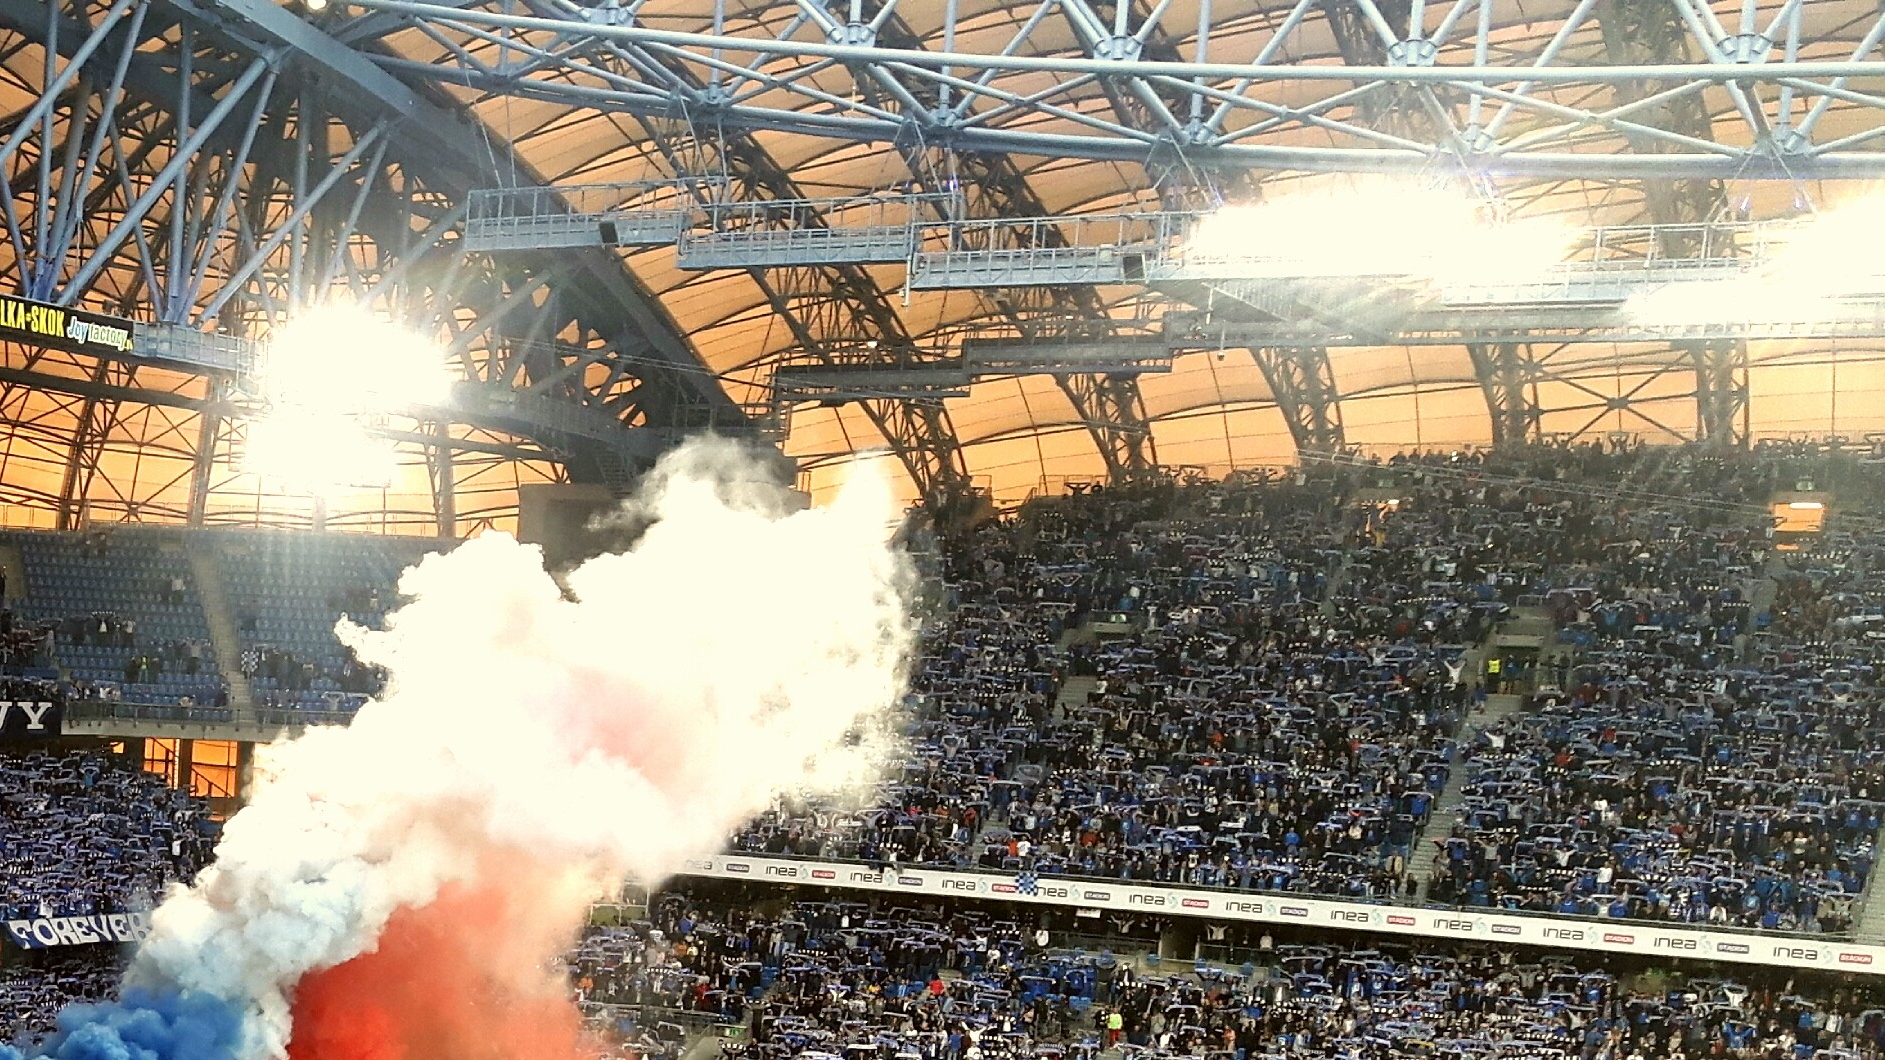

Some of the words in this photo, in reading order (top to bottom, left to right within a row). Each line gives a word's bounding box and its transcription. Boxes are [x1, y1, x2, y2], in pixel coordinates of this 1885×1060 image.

[765, 864, 797, 877] inea
[849, 871, 883, 883] inea
[942, 878, 976, 891] inea
[1036, 885, 1067, 898] nea
[1129, 893, 1165, 906] inea
[1225, 901, 1263, 914] inea
[1330, 910, 1368, 923] inea
[1387, 915, 1415, 926] STADION
[1433, 918, 1472, 931] inea
[8, 913, 152, 950] FOREVER
[1543, 927, 1584, 941] inea
[1603, 933, 1634, 945] STADION
[1654, 936, 1696, 950] inea
[1773, 946, 1818, 961] inea
[1839, 953, 1873, 964] STADION
